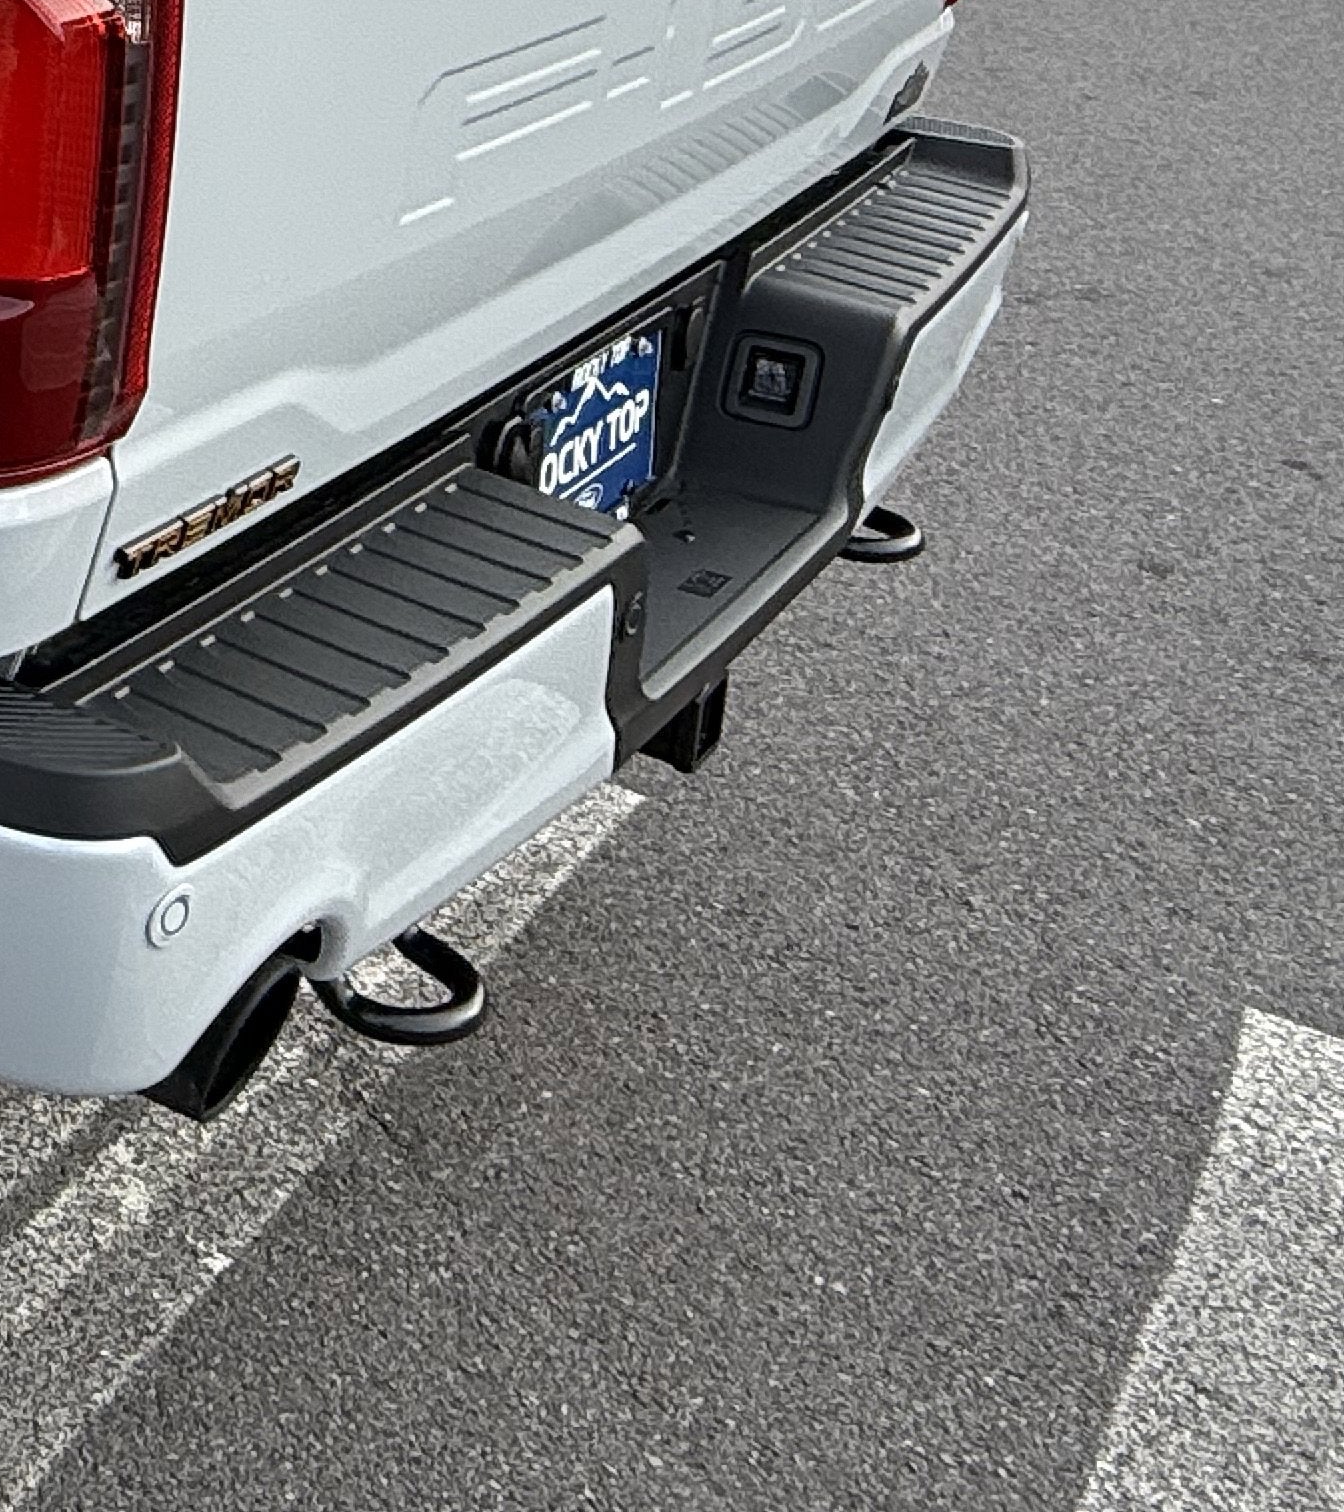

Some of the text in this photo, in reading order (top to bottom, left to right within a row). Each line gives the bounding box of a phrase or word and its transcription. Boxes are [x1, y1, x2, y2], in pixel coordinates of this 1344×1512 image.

[539, 389, 650, 496] OCKY TOP
[113, 453, 301, 580] TREMOR
